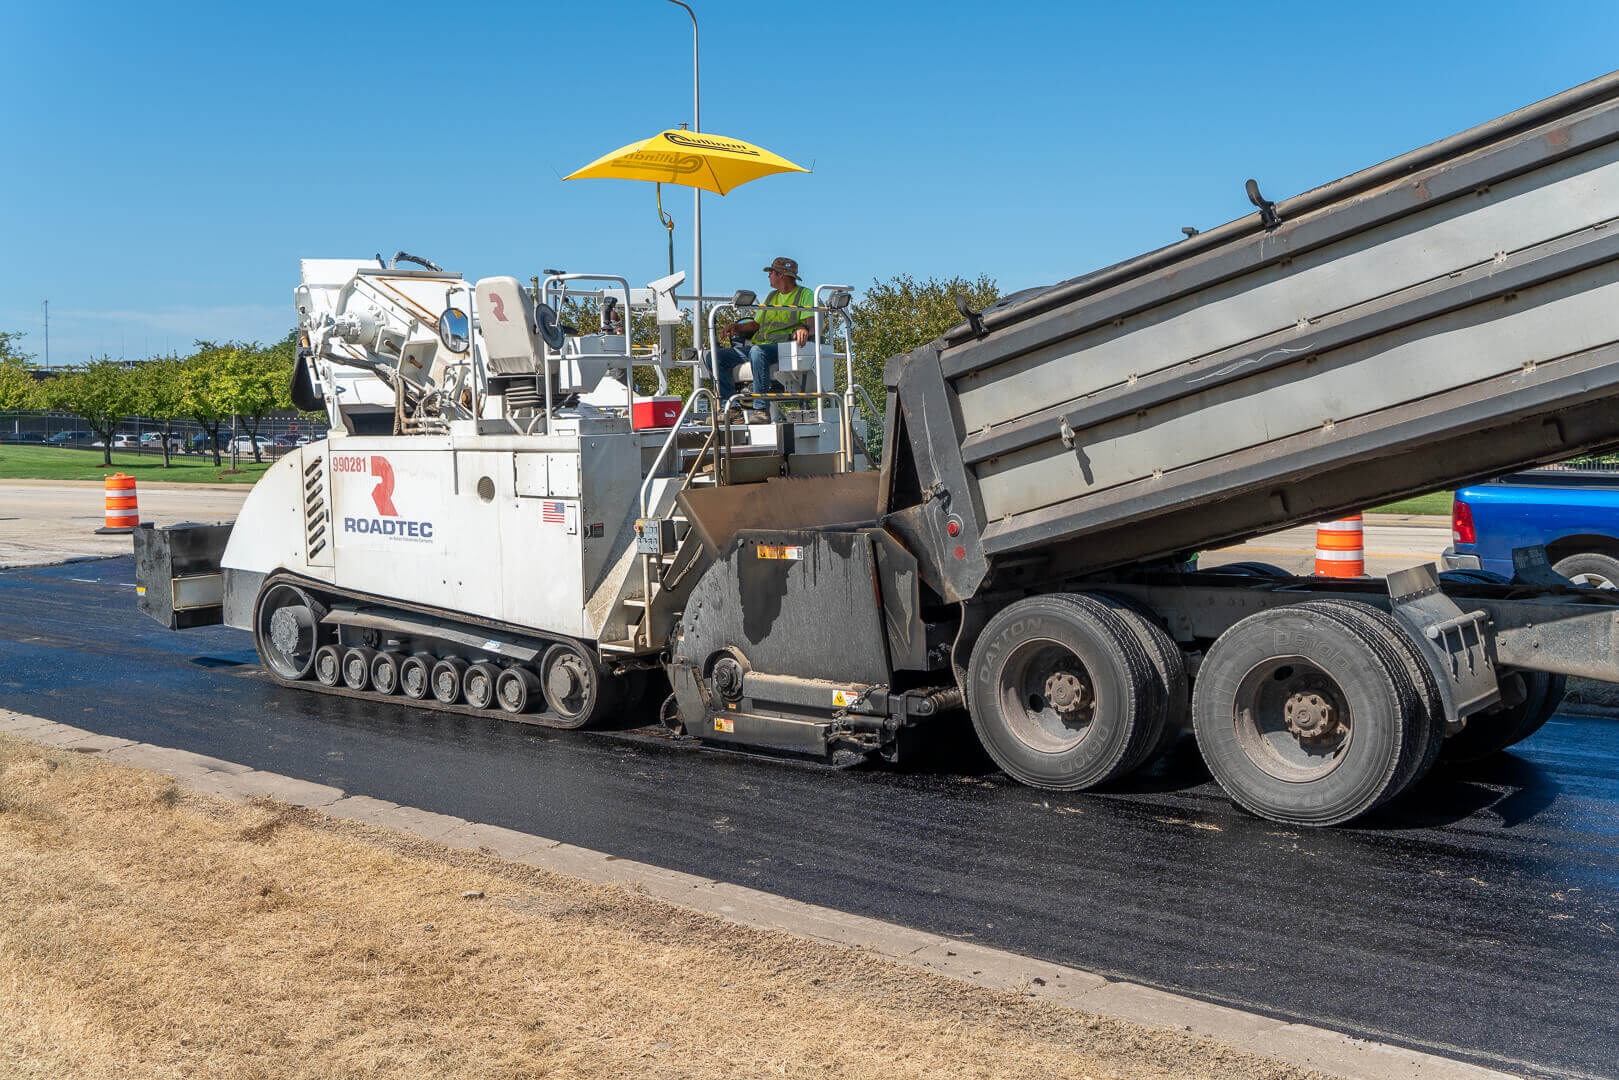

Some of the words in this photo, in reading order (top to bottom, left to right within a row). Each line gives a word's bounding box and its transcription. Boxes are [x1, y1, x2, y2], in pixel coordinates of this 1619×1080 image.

[332, 456, 367, 473] 990281
[344, 517, 433, 538] ROADTEC
[980, 616, 1042, 684] DAYTON
